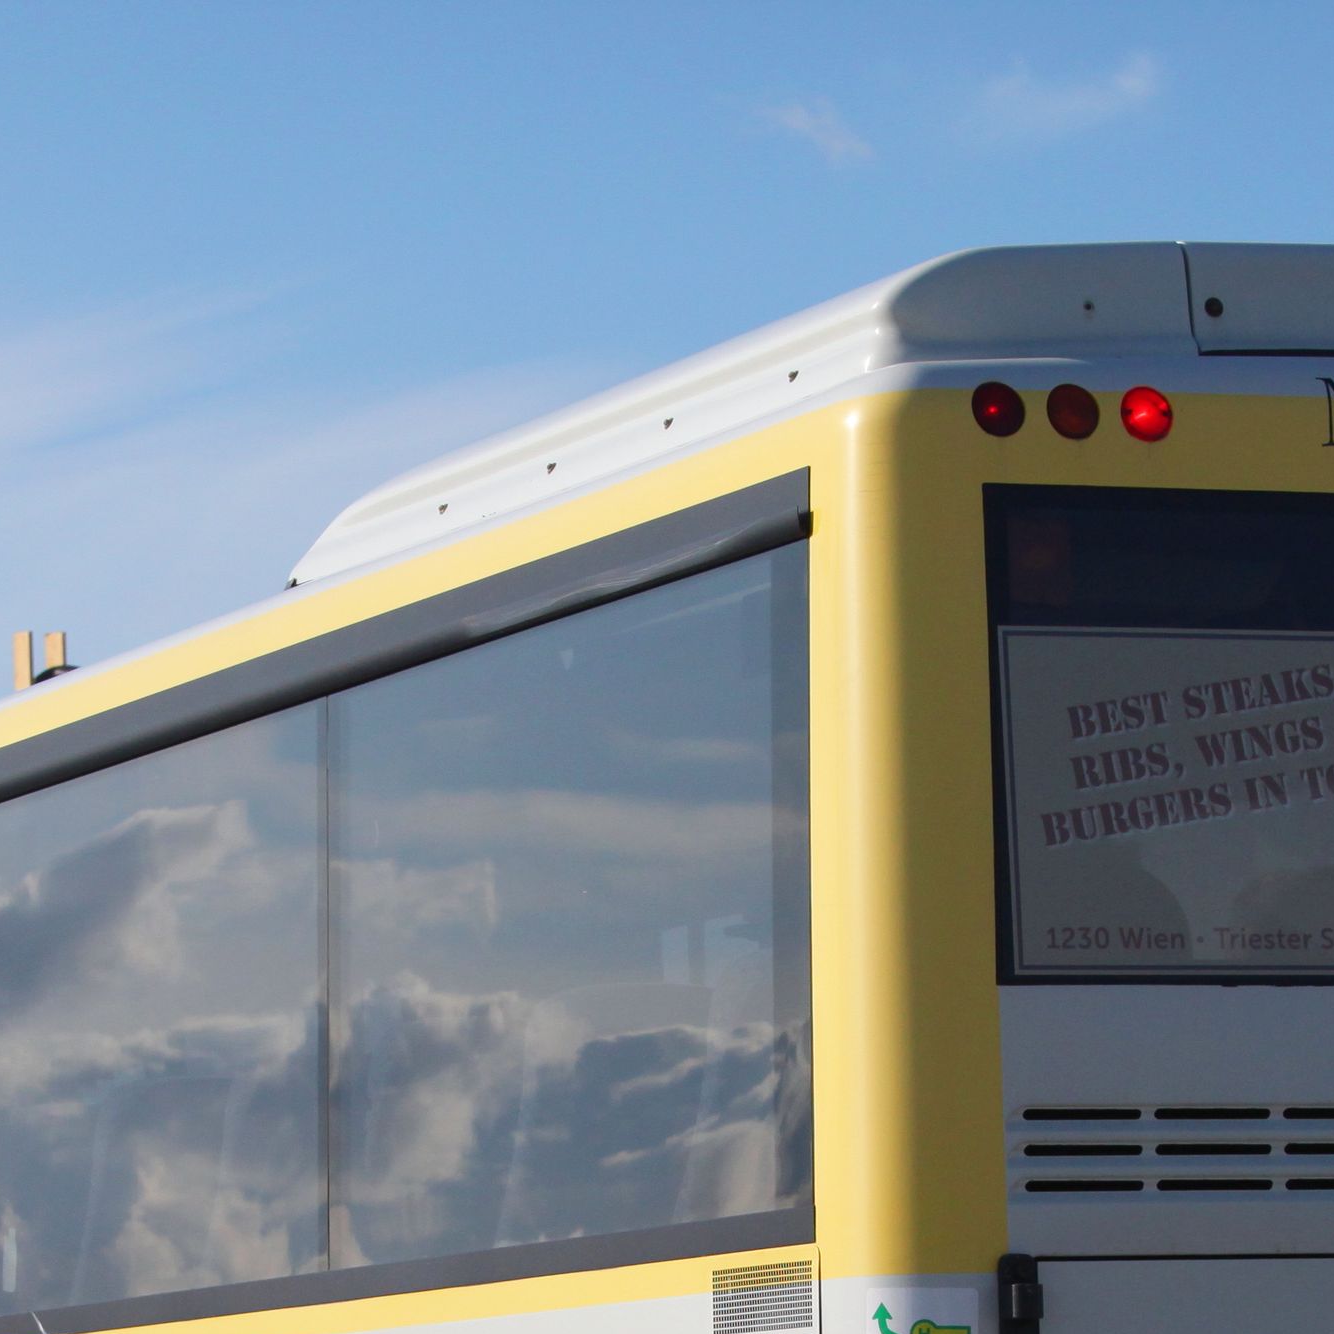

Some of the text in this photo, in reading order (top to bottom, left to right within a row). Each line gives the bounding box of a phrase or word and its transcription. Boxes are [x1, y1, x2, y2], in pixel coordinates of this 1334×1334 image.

[1067, 690, 1169, 740] BEST
[1070, 742, 1186, 790] RIBS,
[1195, 716, 1325, 768] WINGS
[1040, 782, 1233, 847] BURGERS
[1243, 772, 1290, 811] IN
[1046, 926, 1110, 951] 1230
[1118, 926, 1186, 950] Wien
[1214, 927, 1313, 951] Triester
